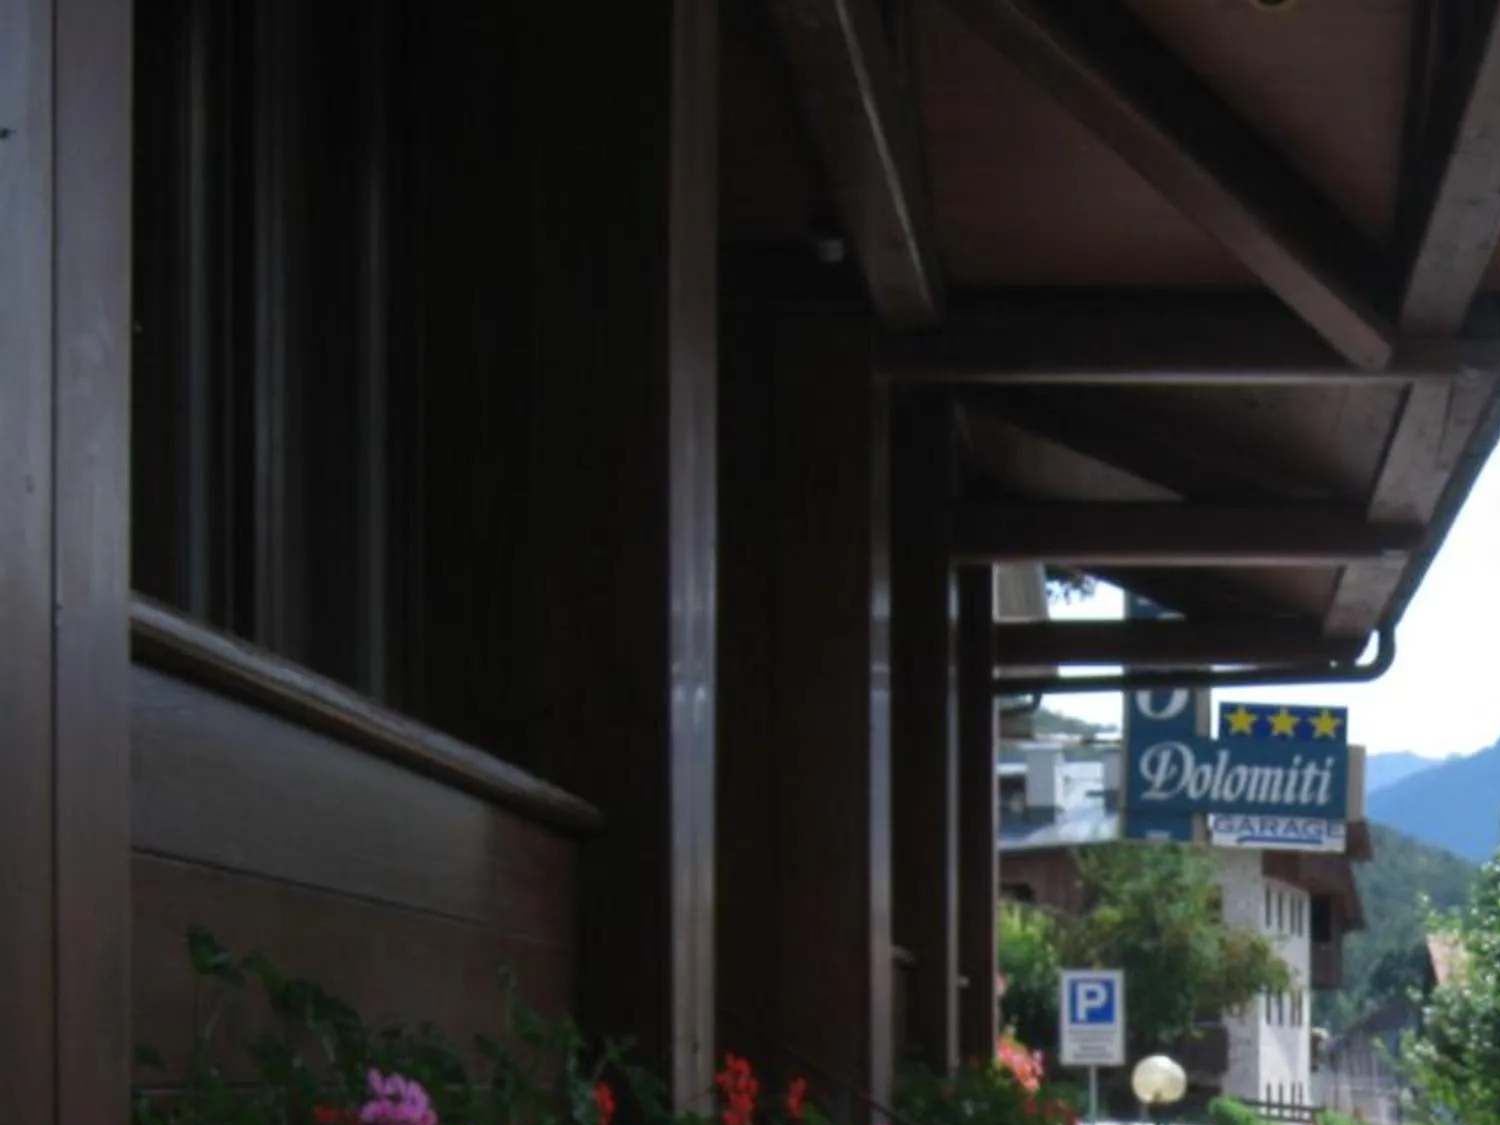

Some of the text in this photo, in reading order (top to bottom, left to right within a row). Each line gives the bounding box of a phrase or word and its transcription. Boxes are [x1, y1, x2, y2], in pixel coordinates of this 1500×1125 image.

[1138, 741, 1335, 805] Dolomiti
[1212, 815, 1345, 838] GARAGE
[1077, 983, 1107, 1020] P
